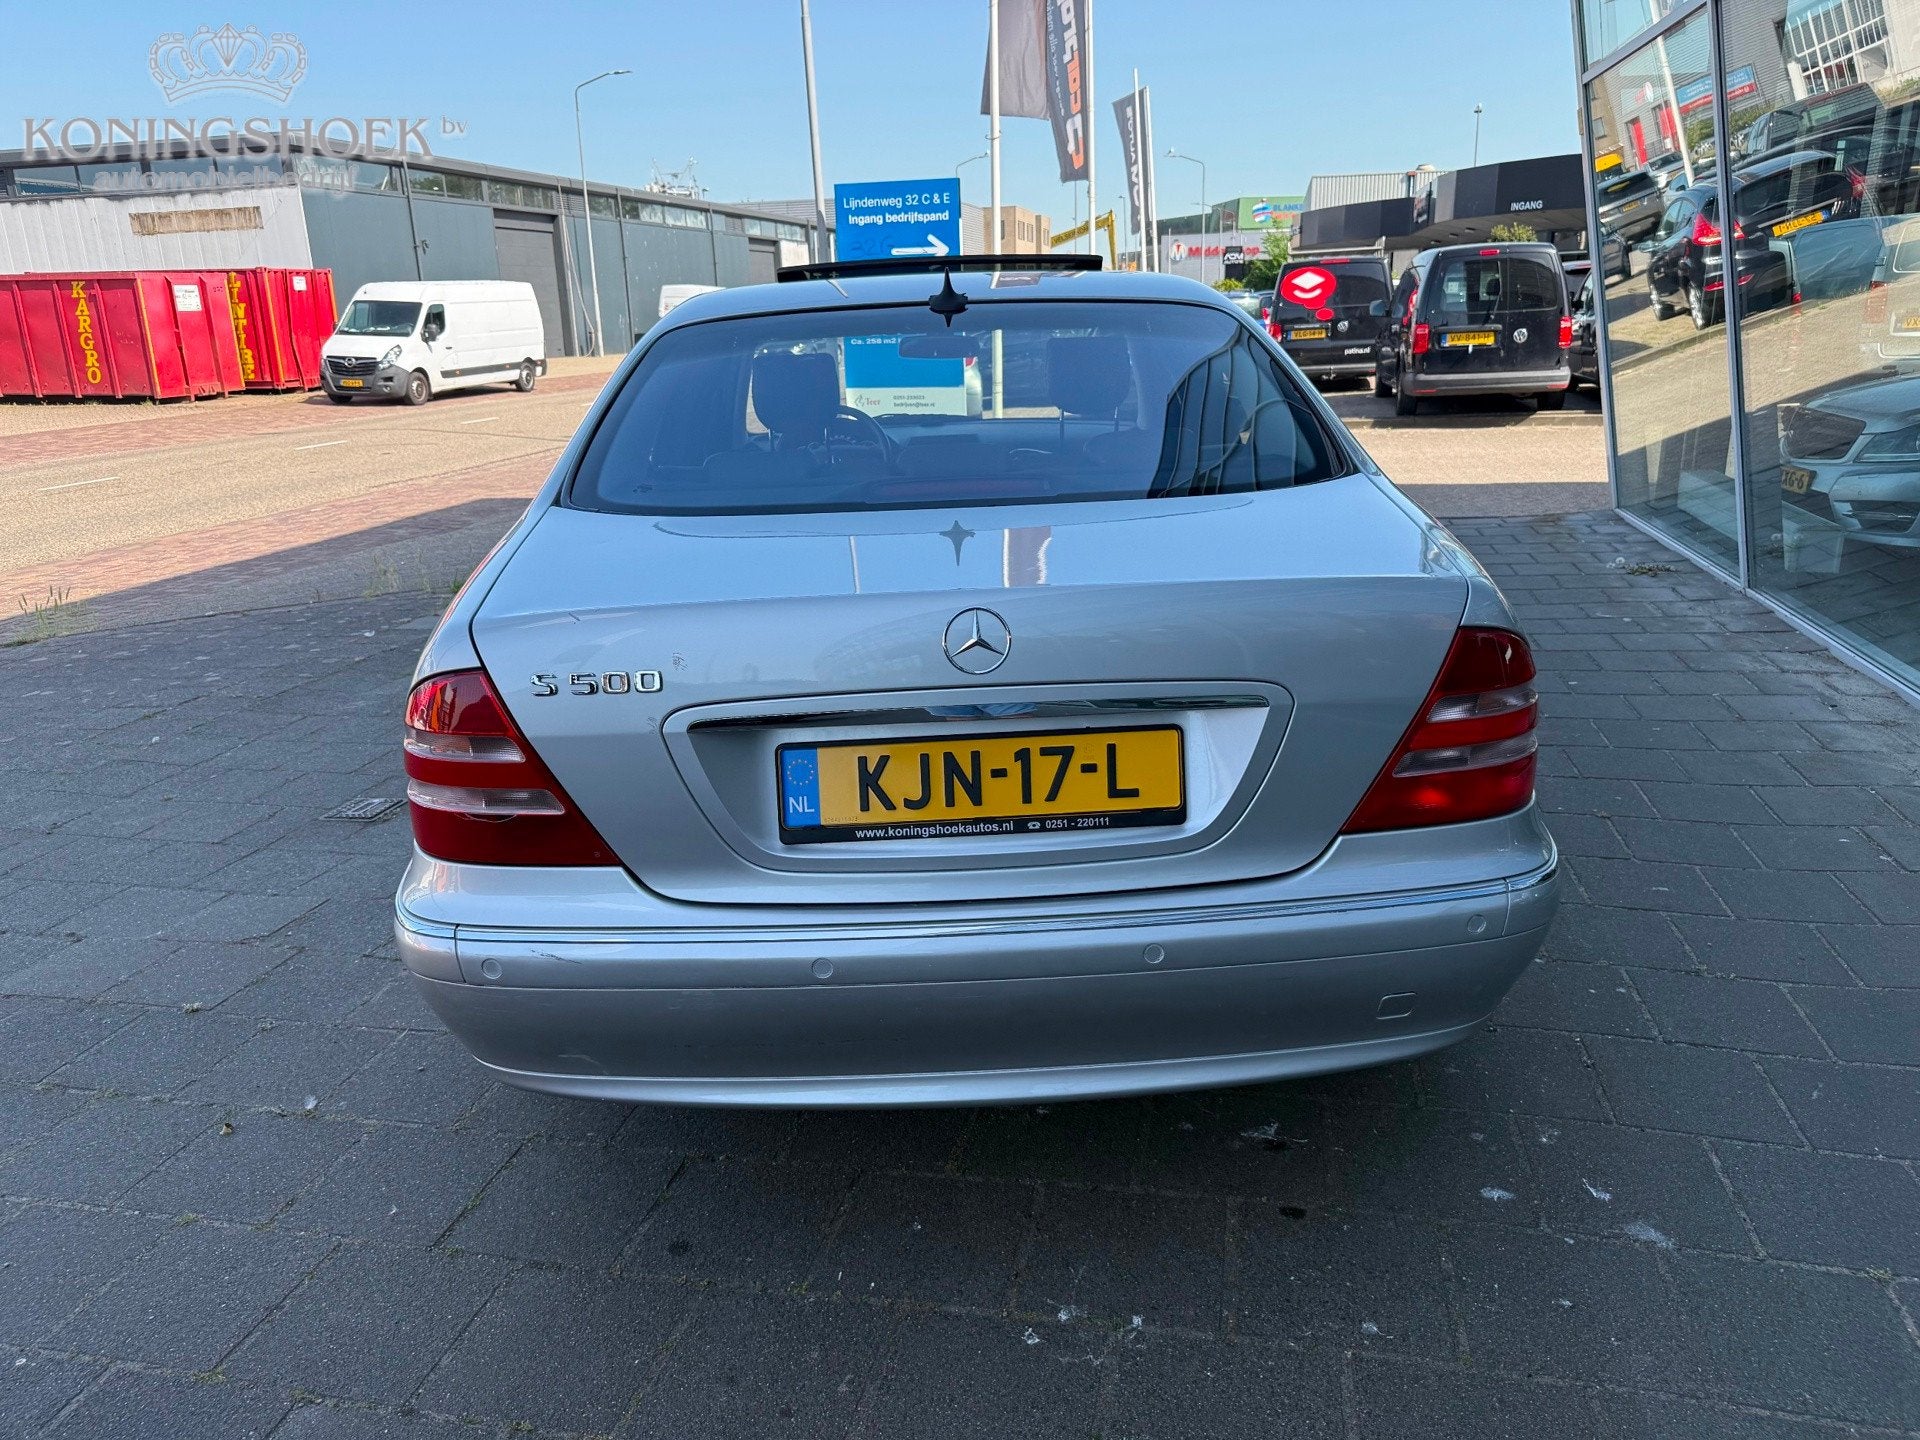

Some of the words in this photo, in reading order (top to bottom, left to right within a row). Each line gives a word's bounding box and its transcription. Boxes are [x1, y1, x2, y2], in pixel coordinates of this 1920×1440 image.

[843, 197, 902, 210] Lijndenweg
[905, 194, 919, 206] 32
[922, 193, 930, 205] C
[933, 192, 940, 204] &
[943, 192, 951, 204] E
[1510, 200, 1543, 211] INGANG
[848, 213, 883, 226] Ingang
[885, 210, 950, 224] bedrijfspand
[70, 280, 102, 384] KARGRO
[1344, 346, 1371, 355] patina.nl
[530, 672, 559, 697] S
[569, 670, 663, 696] 500
[857, 743, 1140, 812] KJN-17-L
[789, 796, 815, 813] NL
[855, 821, 1014, 840] www.koningshoekautos.nl
[1045, 818, 1068, 829] 0251
[1077, 816, 1110, 828] 220111
